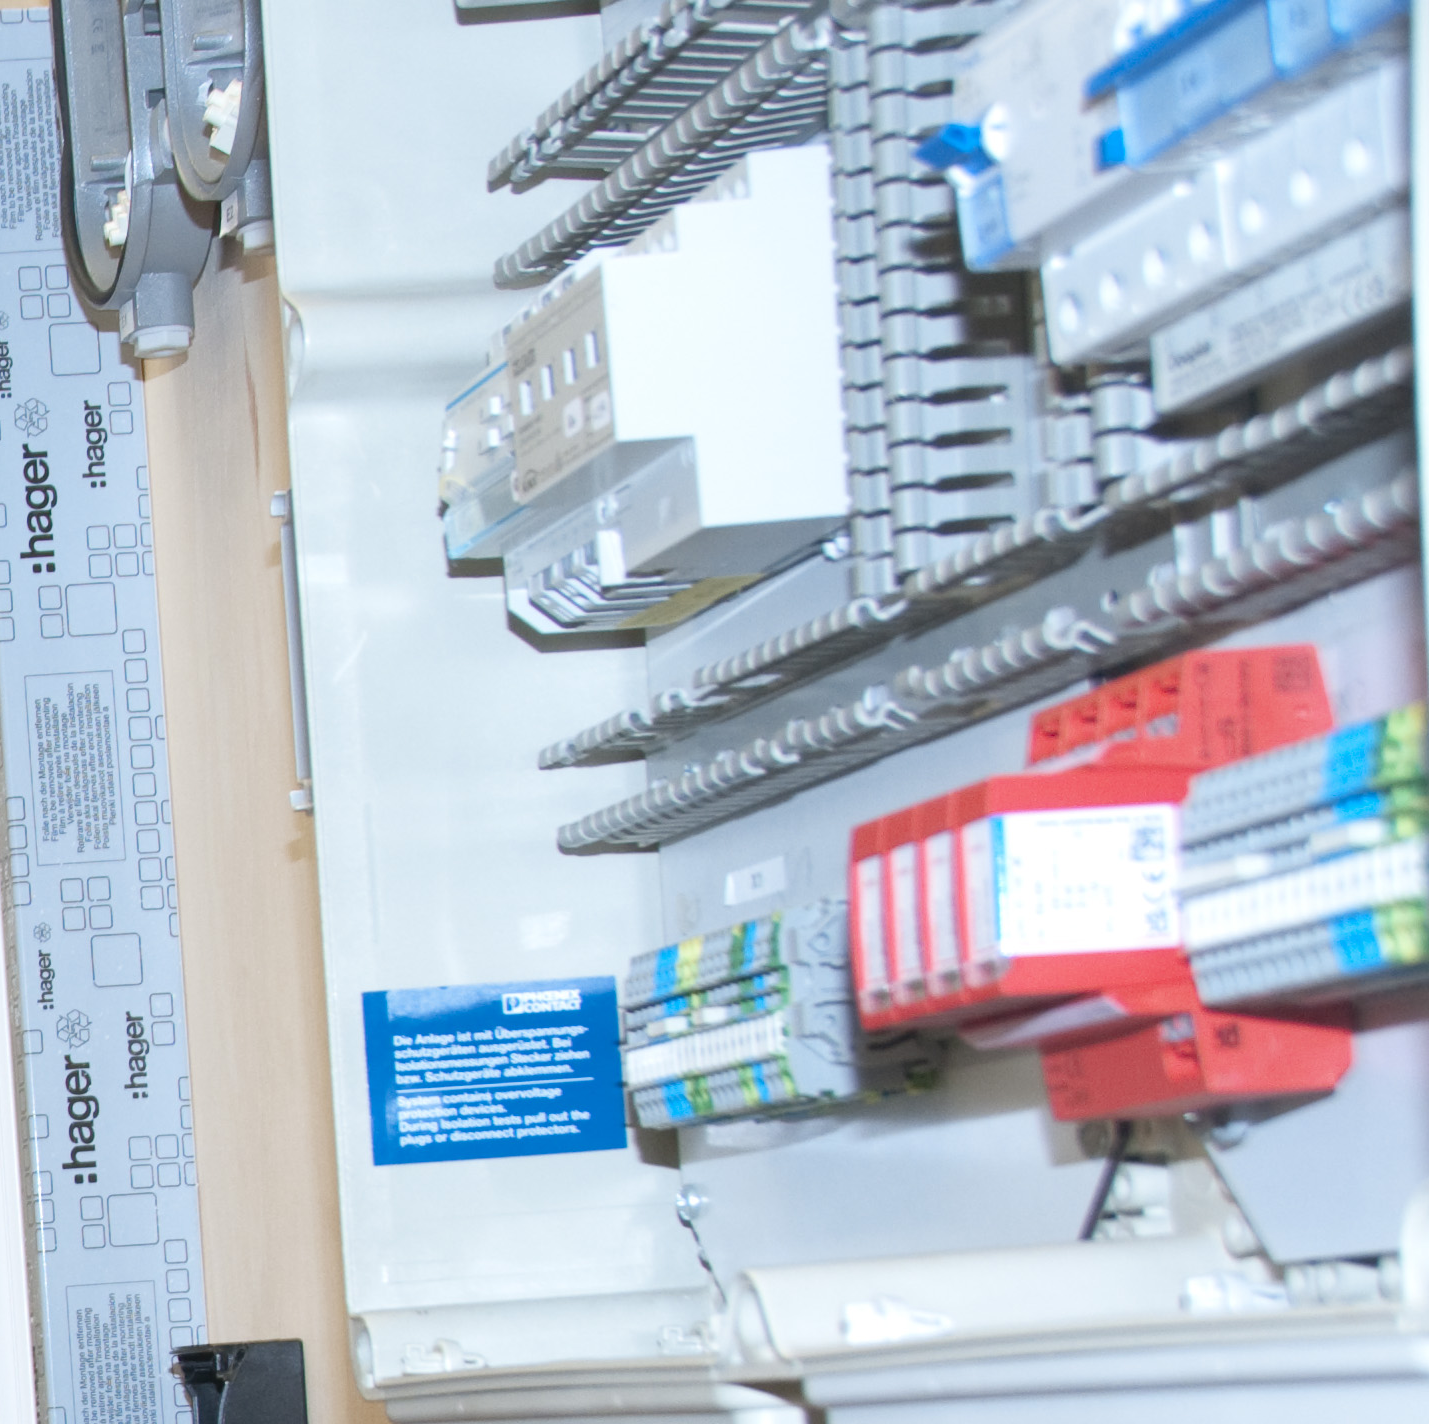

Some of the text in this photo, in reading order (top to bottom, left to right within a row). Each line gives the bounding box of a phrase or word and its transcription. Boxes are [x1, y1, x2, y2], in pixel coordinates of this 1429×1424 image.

[524, 1000, 581, 1013] CONTACT
[393, 1035, 413, 1046] Die
[415, 1034, 455, 1045] Anlage
[457, 1031, 471, 1042] ist
[473, 1030, 493, 1040] mit
[394, 1037, 572, 1059] schutzgeräten ausgerüstet. Bei
[395, 1050, 590, 1072] Isolationsmessungen Stecker ziehen
[425, 1068, 501, 1082] Schutzgeräte
[503, 1064, 574, 1077] abklemmen.
[397, 1096, 441, 1108] System
[495, 1088, 562, 1100] overvoltage
[398, 1104, 507, 1121] protection devices.
[399, 1121, 439, 1133] During
[493, 1116, 522, 1126] tests
[524, 1112, 546, 1125] pull
[548, 1112, 569, 1122] out
[571, 1110, 590, 1120] the
[400, 1125, 581, 1147] plugs or disconnect protectors.
